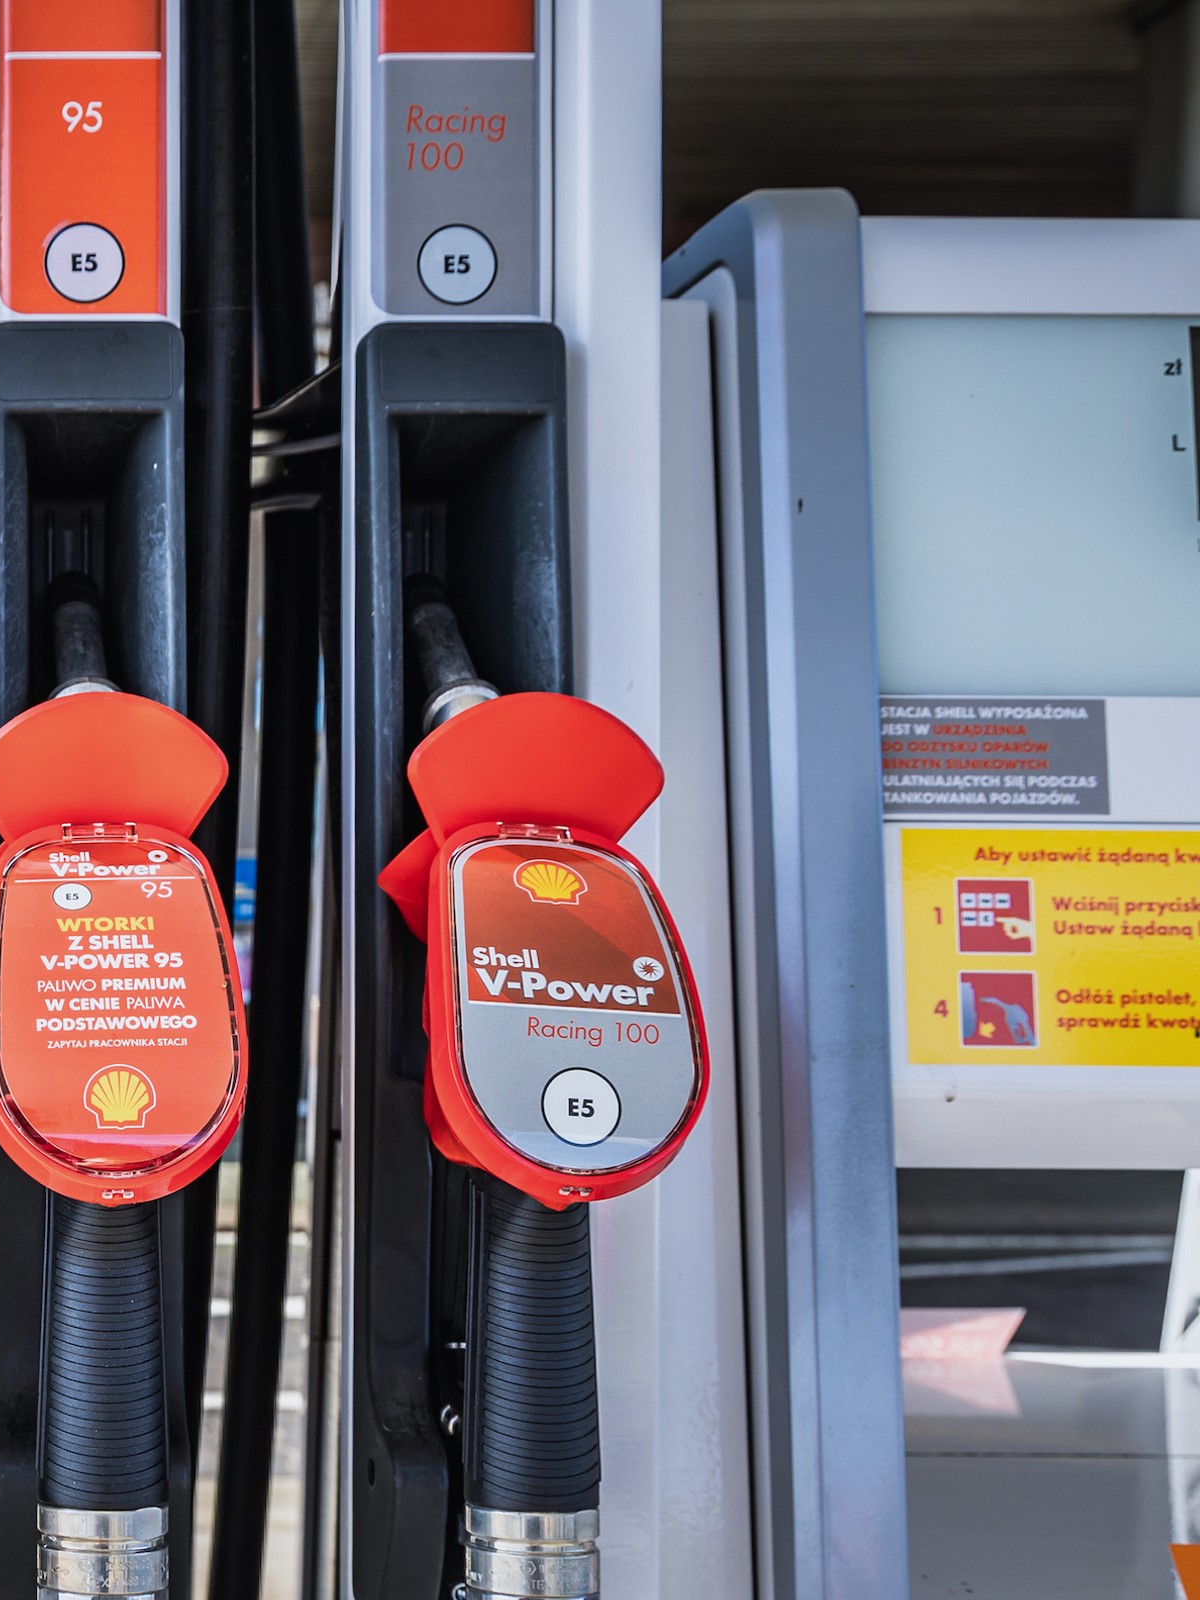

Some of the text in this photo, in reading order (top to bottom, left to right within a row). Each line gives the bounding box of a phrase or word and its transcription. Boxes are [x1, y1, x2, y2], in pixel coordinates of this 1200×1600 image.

[61, 100, 103, 133] 95
[406, 103, 507, 143] Racing
[406, 141, 465, 171] 100
[71, 252, 98, 272] E5
[443, 254, 471, 274] E5
[1163, 357, 1183, 376] zł
[1172, 434, 1186, 452] L
[880, 703, 1089, 719] STACJA SHELL WYPOSAŻONA
[881, 723, 1028, 738] JEST W URZĄDZENIA
[908, 740, 978, 753] ODZYSKU
[982, 737, 1050, 753] OPARÓW
[883, 758, 1050, 770] BENZYN SILNIKOWYCH
[883, 774, 1097, 790] ULATNIAJĄCYCH SIĘ PODCZAS
[883, 789, 1080, 805] TANKOWANIA POJAZDÓW.
[49, 852, 90, 864] Shell
[974, 846, 1011, 865] Aby
[1018, 846, 1091, 863] ustawić
[1097, 846, 1170, 867] żądaną
[50, 863, 161, 878] V-Power
[65, 881, 173, 901] E5 95
[1051, 896, 1120, 916] Wciśnij
[56, 917, 154, 932] WTORKI
[933, 907, 943, 925] 1
[1053, 921, 1193, 940] Ustaw żądaną
[68, 935, 154, 950] Z SHELL
[40, 953, 183, 970] V-POWER 95
[472, 946, 540, 969] Shell
[37, 977, 186, 993] PALIWO PREMIUM
[475, 967, 655, 1006] V-Power
[44, 996, 185, 1011] W CENIE PALIWA
[1055, 988, 1197, 1008] Odłóż pistolet,
[933, 999, 949, 1018] 4
[36, 1016, 197, 1032] PODSTAWOWEGO
[527, 1016, 660, 1047] Racing 100
[1056, 1013, 1141, 1033] sprawdź
[47, 1038, 188, 1049] ZAPYTAJ PRACOWNIKA STACJI
[567, 1097, 595, 1118] E5
